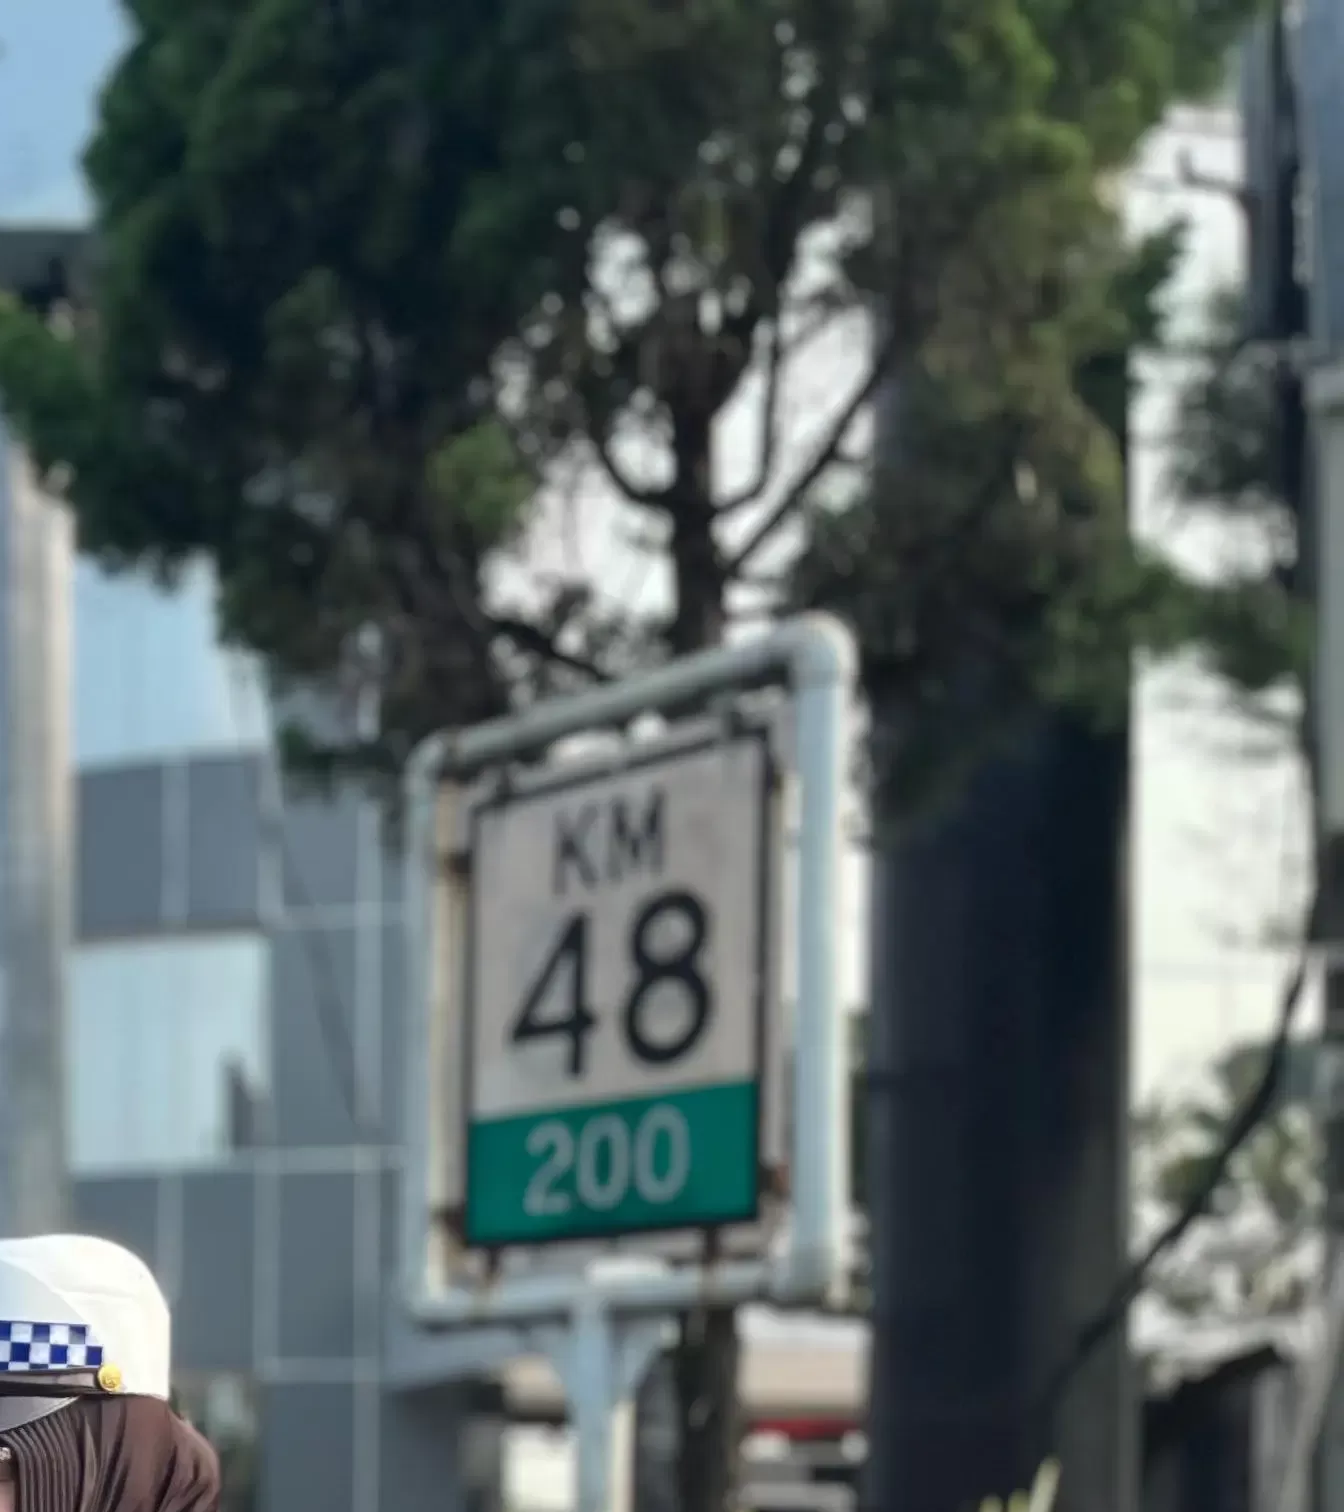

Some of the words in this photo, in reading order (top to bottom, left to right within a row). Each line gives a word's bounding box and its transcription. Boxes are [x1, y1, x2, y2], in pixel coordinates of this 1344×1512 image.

[553, 790, 667, 894] KM
[509, 889, 709, 1078] 48
[523, 1103, 690, 1215] 200
